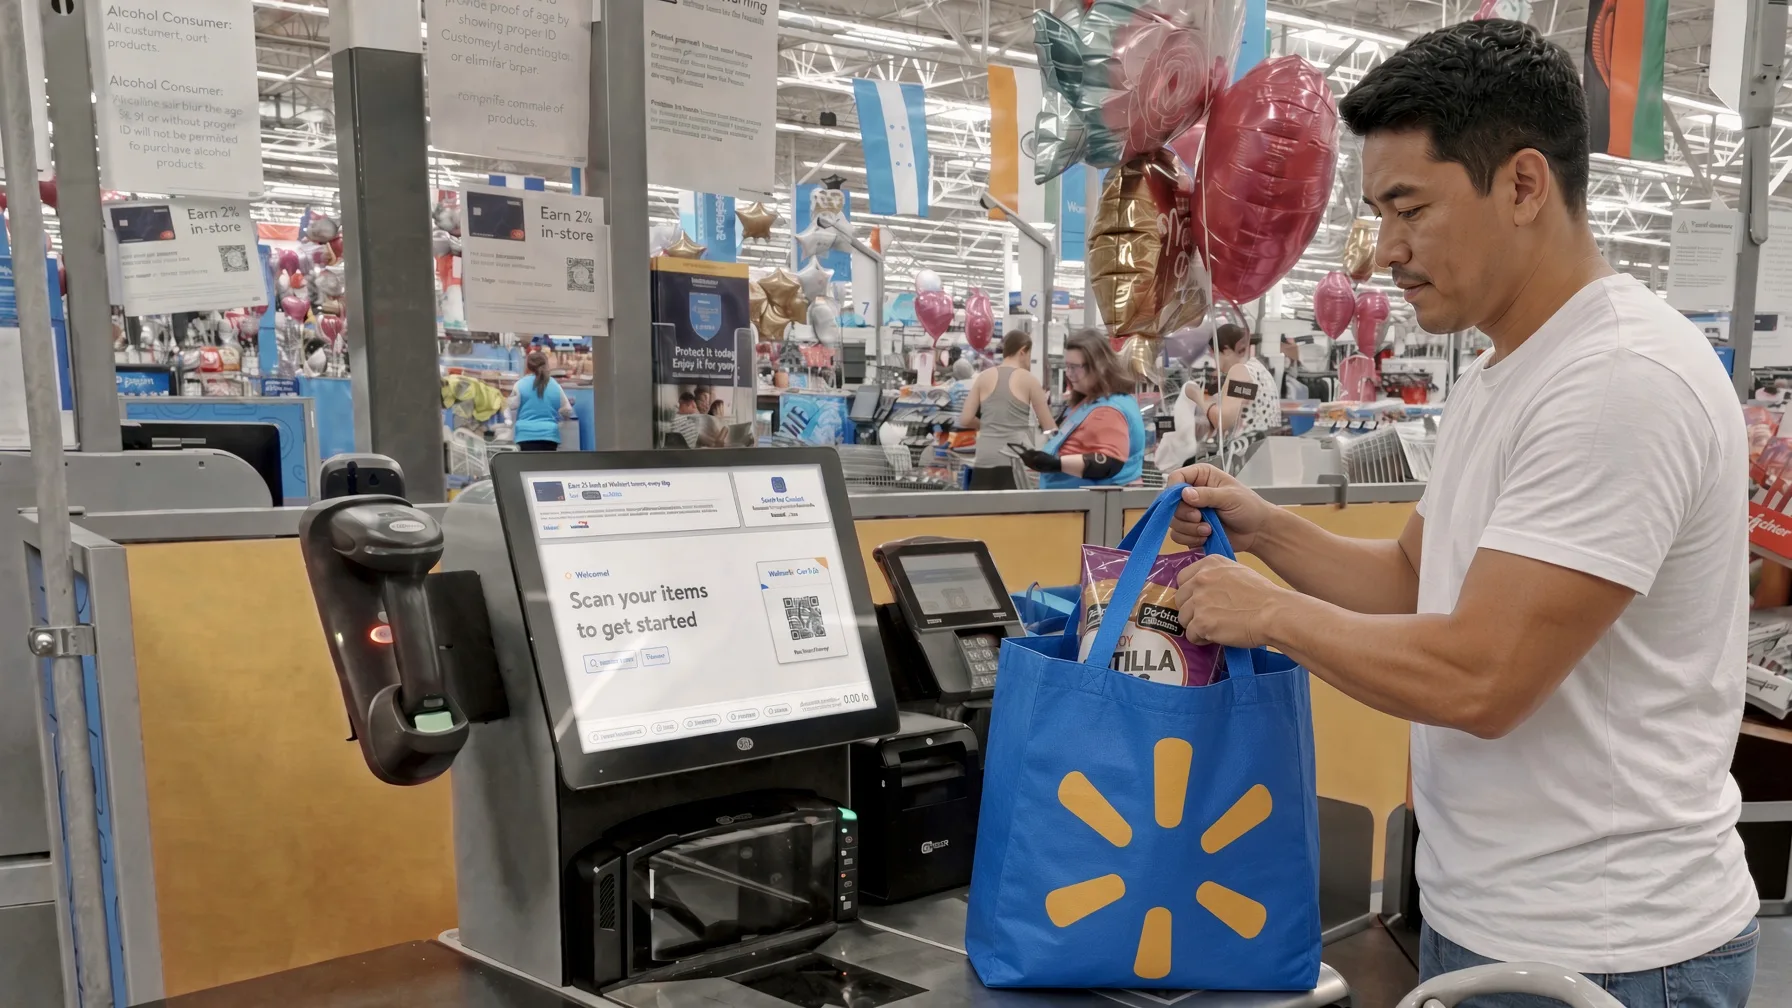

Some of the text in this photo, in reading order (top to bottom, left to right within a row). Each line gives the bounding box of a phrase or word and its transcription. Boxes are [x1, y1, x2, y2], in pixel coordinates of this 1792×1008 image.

[107, 5, 233, 30] Alcohol Consumer:
[490, 2, 520, 15] proof
[522, 7, 535, 19] of
[536, 12, 555, 24] age
[557, 12, 570, 27] by
[107, 22, 122, 33] All
[458, 14, 557, 41] showing proper ID
[108, 38, 160, 53] products.
[450, 52, 463, 62] or
[109, 75, 224, 96] Alcohol Consumer:
[205, 104, 222, 114] the
[224, 107, 244, 119] age
[553, 103, 564, 114] of
[161, 115, 202, 127] without
[487, 113, 537, 128] products.
[119, 125, 131, 135] ID
[134, 126, 151, 137] will
[153, 129, 172, 139] not
[173, 130, 187, 140] be
[194, 147, 231, 157] alcohol
[187, 206, 240, 221] Earn 2%
[540, 206, 593, 224] Earn 2%
[190, 222, 241, 235] in-store
[541, 225, 594, 242] in-store
[1029, 293, 1038, 309] 6
[862, 302, 870, 316] 7
[675, 345, 704, 357] Protect
[672, 358, 695, 371] Enjoy
[704, 358, 716, 370] for
[569, 584, 708, 610] Scan your items
[577, 611, 698, 641] to get started
[1118, 635, 1133, 647] OY
[1111, 649, 1176, 672] TILLA
[843, 692, 860, 705] 0.00
